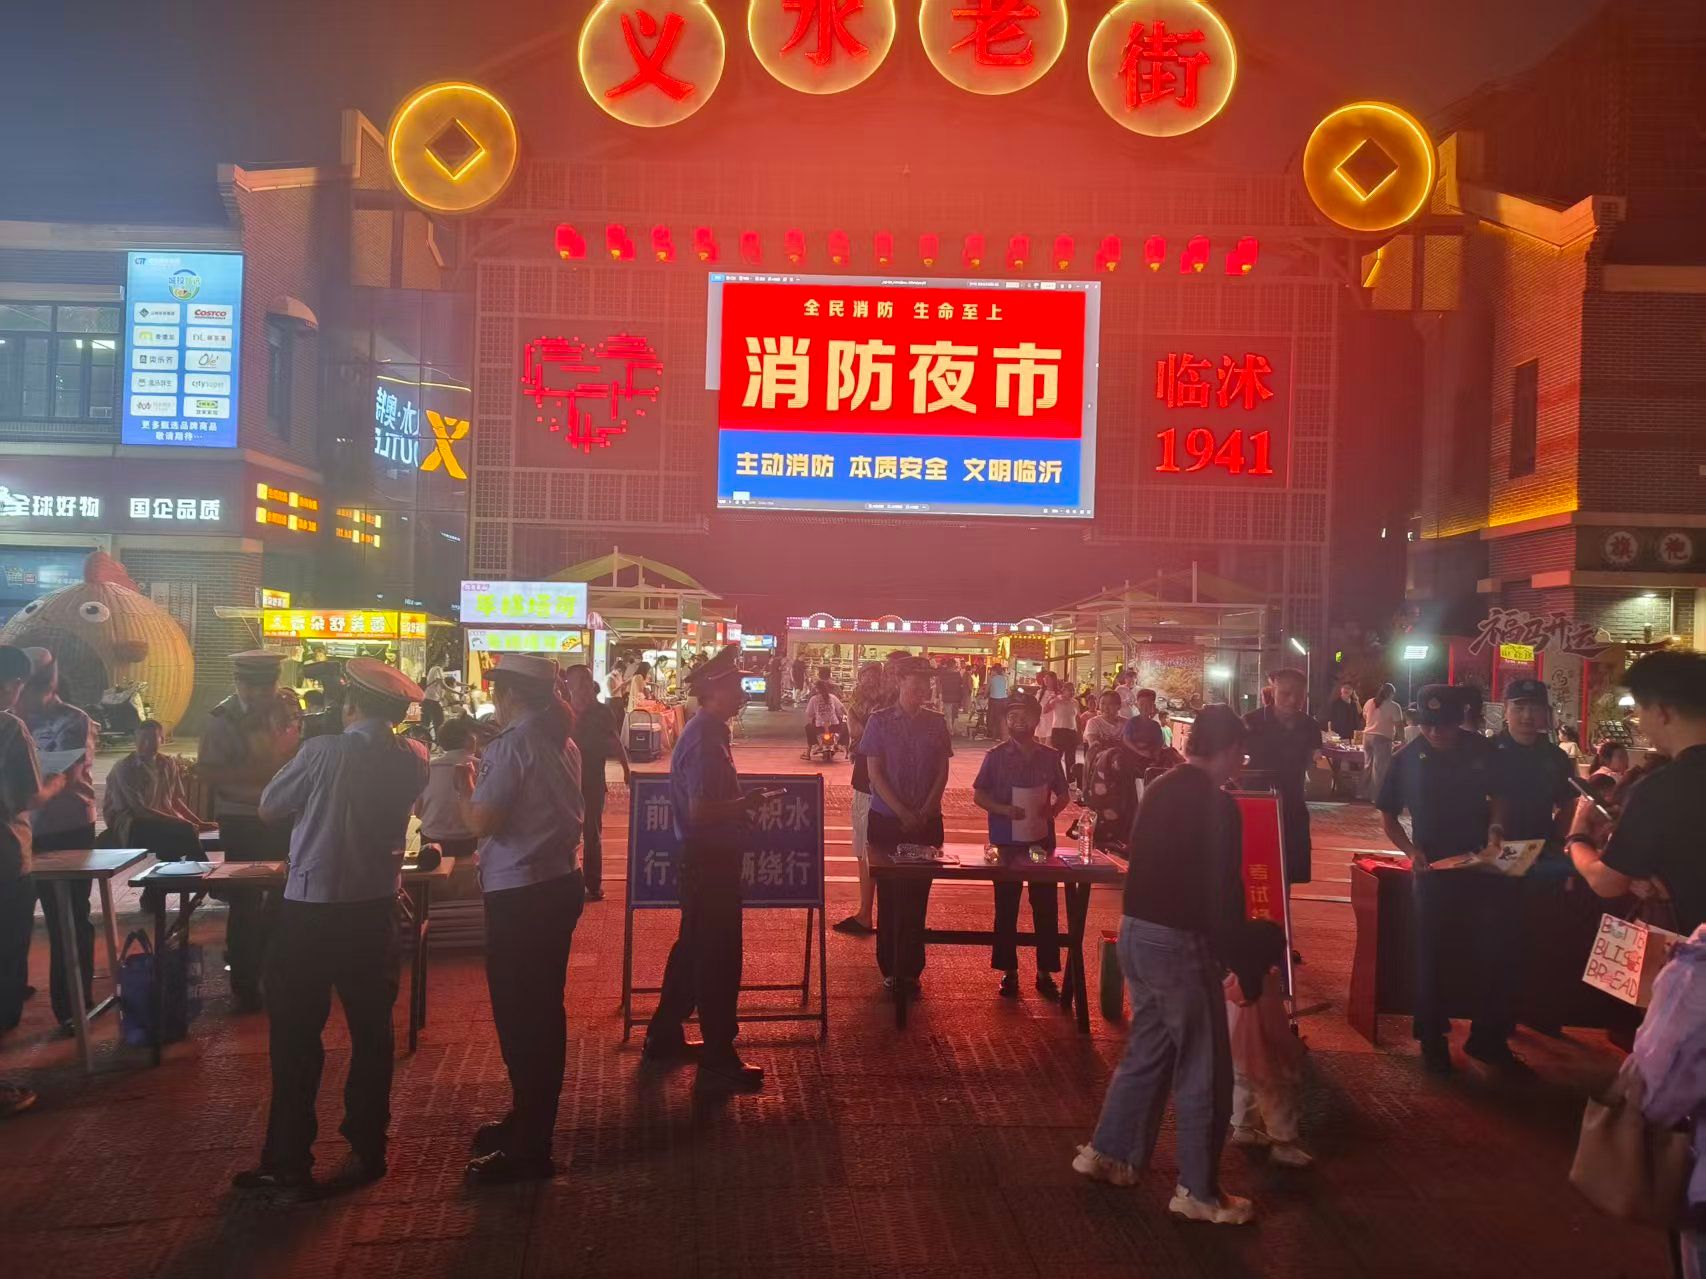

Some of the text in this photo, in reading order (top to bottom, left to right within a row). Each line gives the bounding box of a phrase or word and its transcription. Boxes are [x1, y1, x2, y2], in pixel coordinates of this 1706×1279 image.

[604, 0, 1210, 110] 义水老街
[803, 298, 1003, 321] 全民消防 生命至上
[742, 336, 1062, 417] 消防夜市
[1156, 353, 1274, 410] 临沭
[735, 452, 1062, 485] 主动消防 本质安全 文明临沂
[1155, 427, 1273, 474] 1941
[7, 493, 220, 520] 全球好物 国企品质
